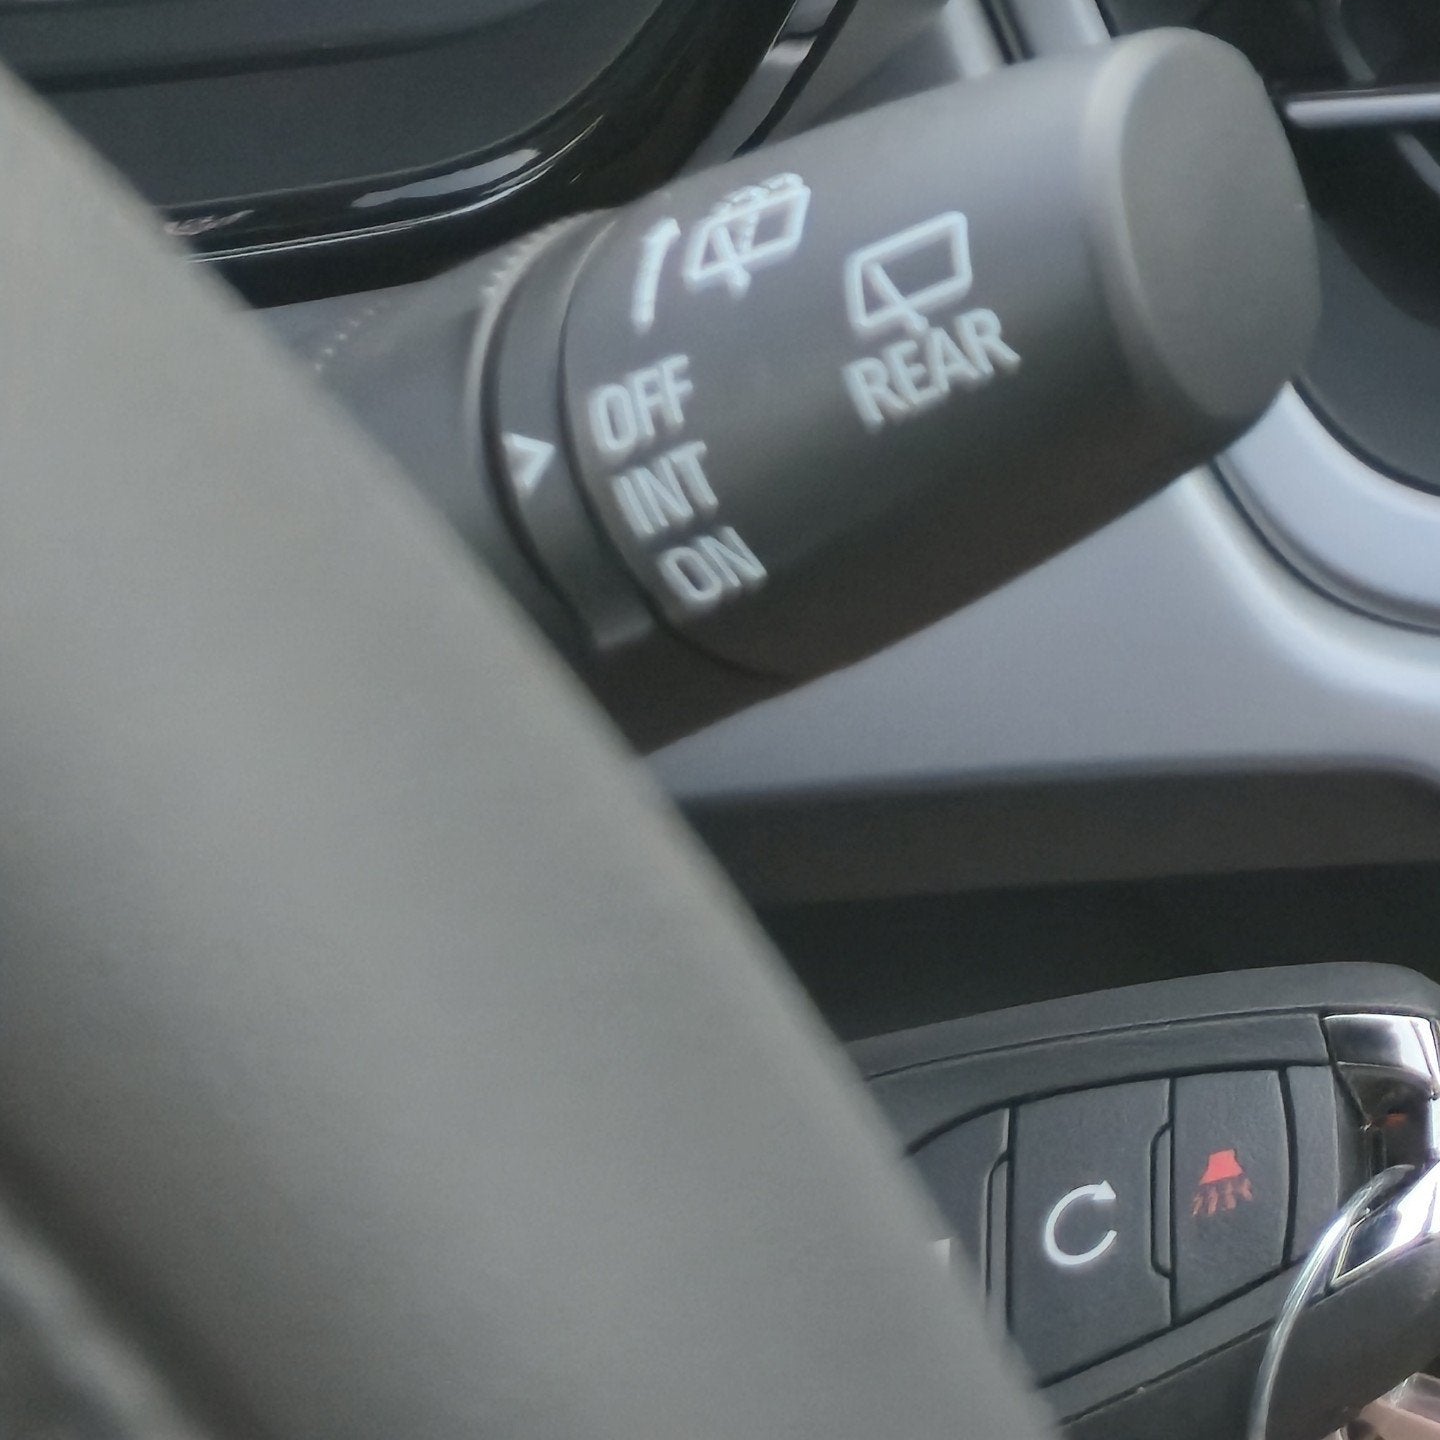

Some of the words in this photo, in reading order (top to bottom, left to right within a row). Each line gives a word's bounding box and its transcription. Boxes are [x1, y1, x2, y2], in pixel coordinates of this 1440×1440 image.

[587, 354, 694, 454] OFF
[841, 307, 1021, 430] REAR
[610, 440, 720, 537] INT
[658, 524, 768, 611] ON
